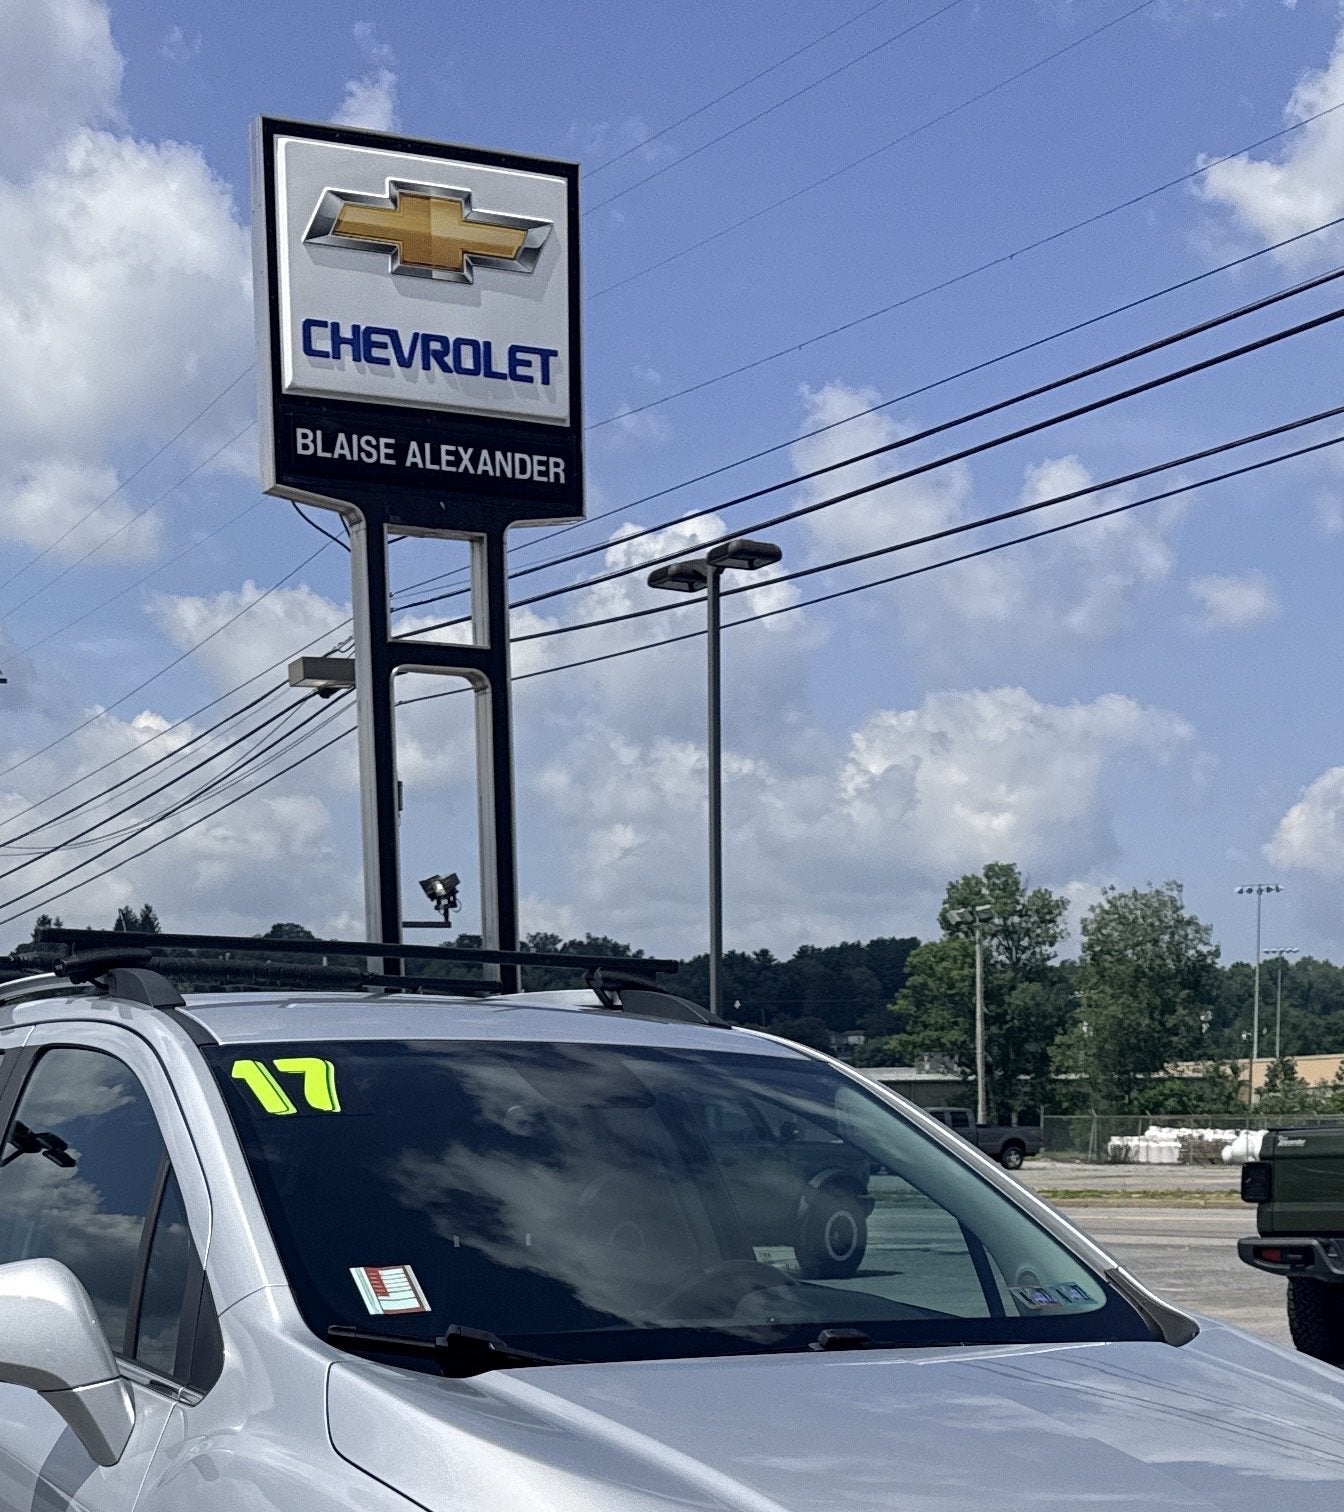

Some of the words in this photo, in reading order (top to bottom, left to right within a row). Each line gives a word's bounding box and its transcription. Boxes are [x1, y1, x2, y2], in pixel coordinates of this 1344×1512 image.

[302, 318, 558, 386] CHEVROLET
[296, 427, 397, 466] BLAISE
[405, 440, 566, 484] ALEXANDER
[231, 1057, 342, 1116] 17
